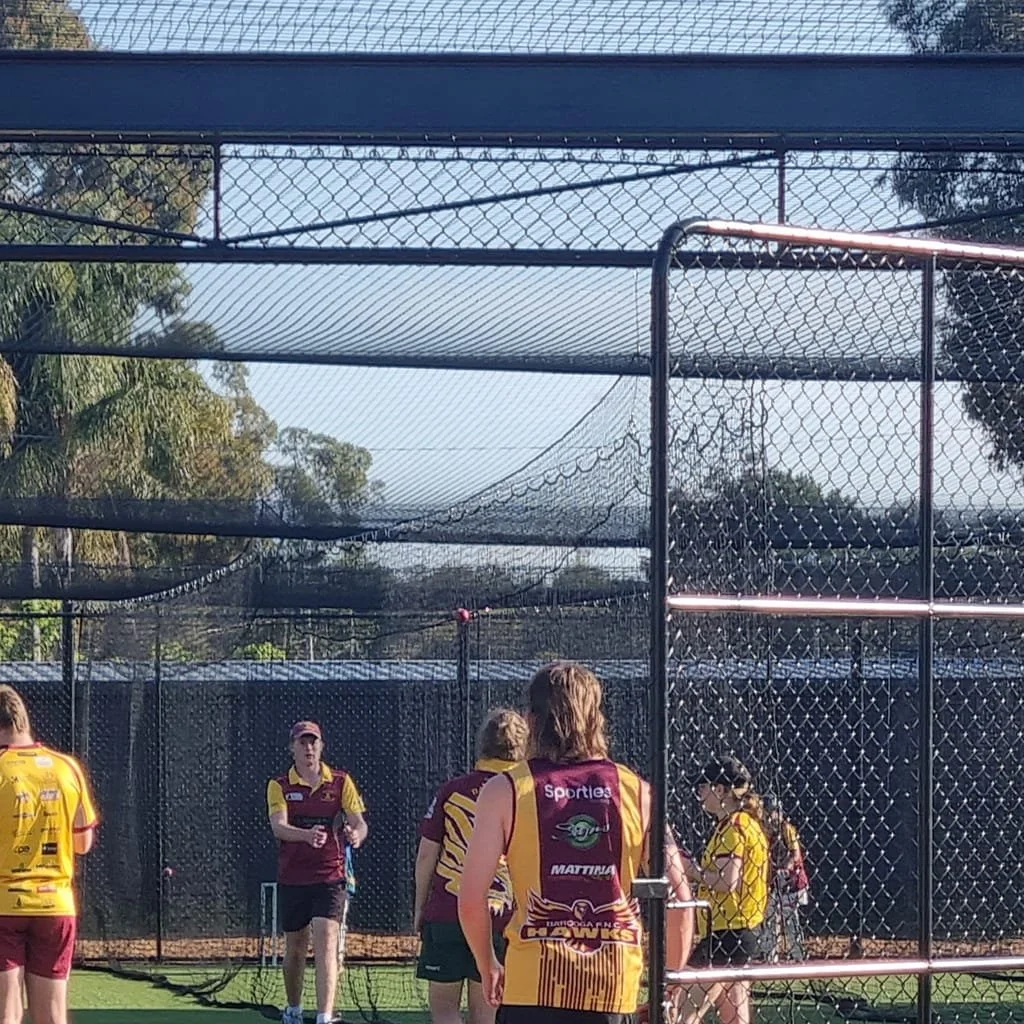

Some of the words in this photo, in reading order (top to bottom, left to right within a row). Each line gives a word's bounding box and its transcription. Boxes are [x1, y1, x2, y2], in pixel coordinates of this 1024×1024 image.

[544, 784, 612, 802] Sporties
[550, 864, 616, 876] MATTINA
[527, 927, 636, 942] HAWKS
